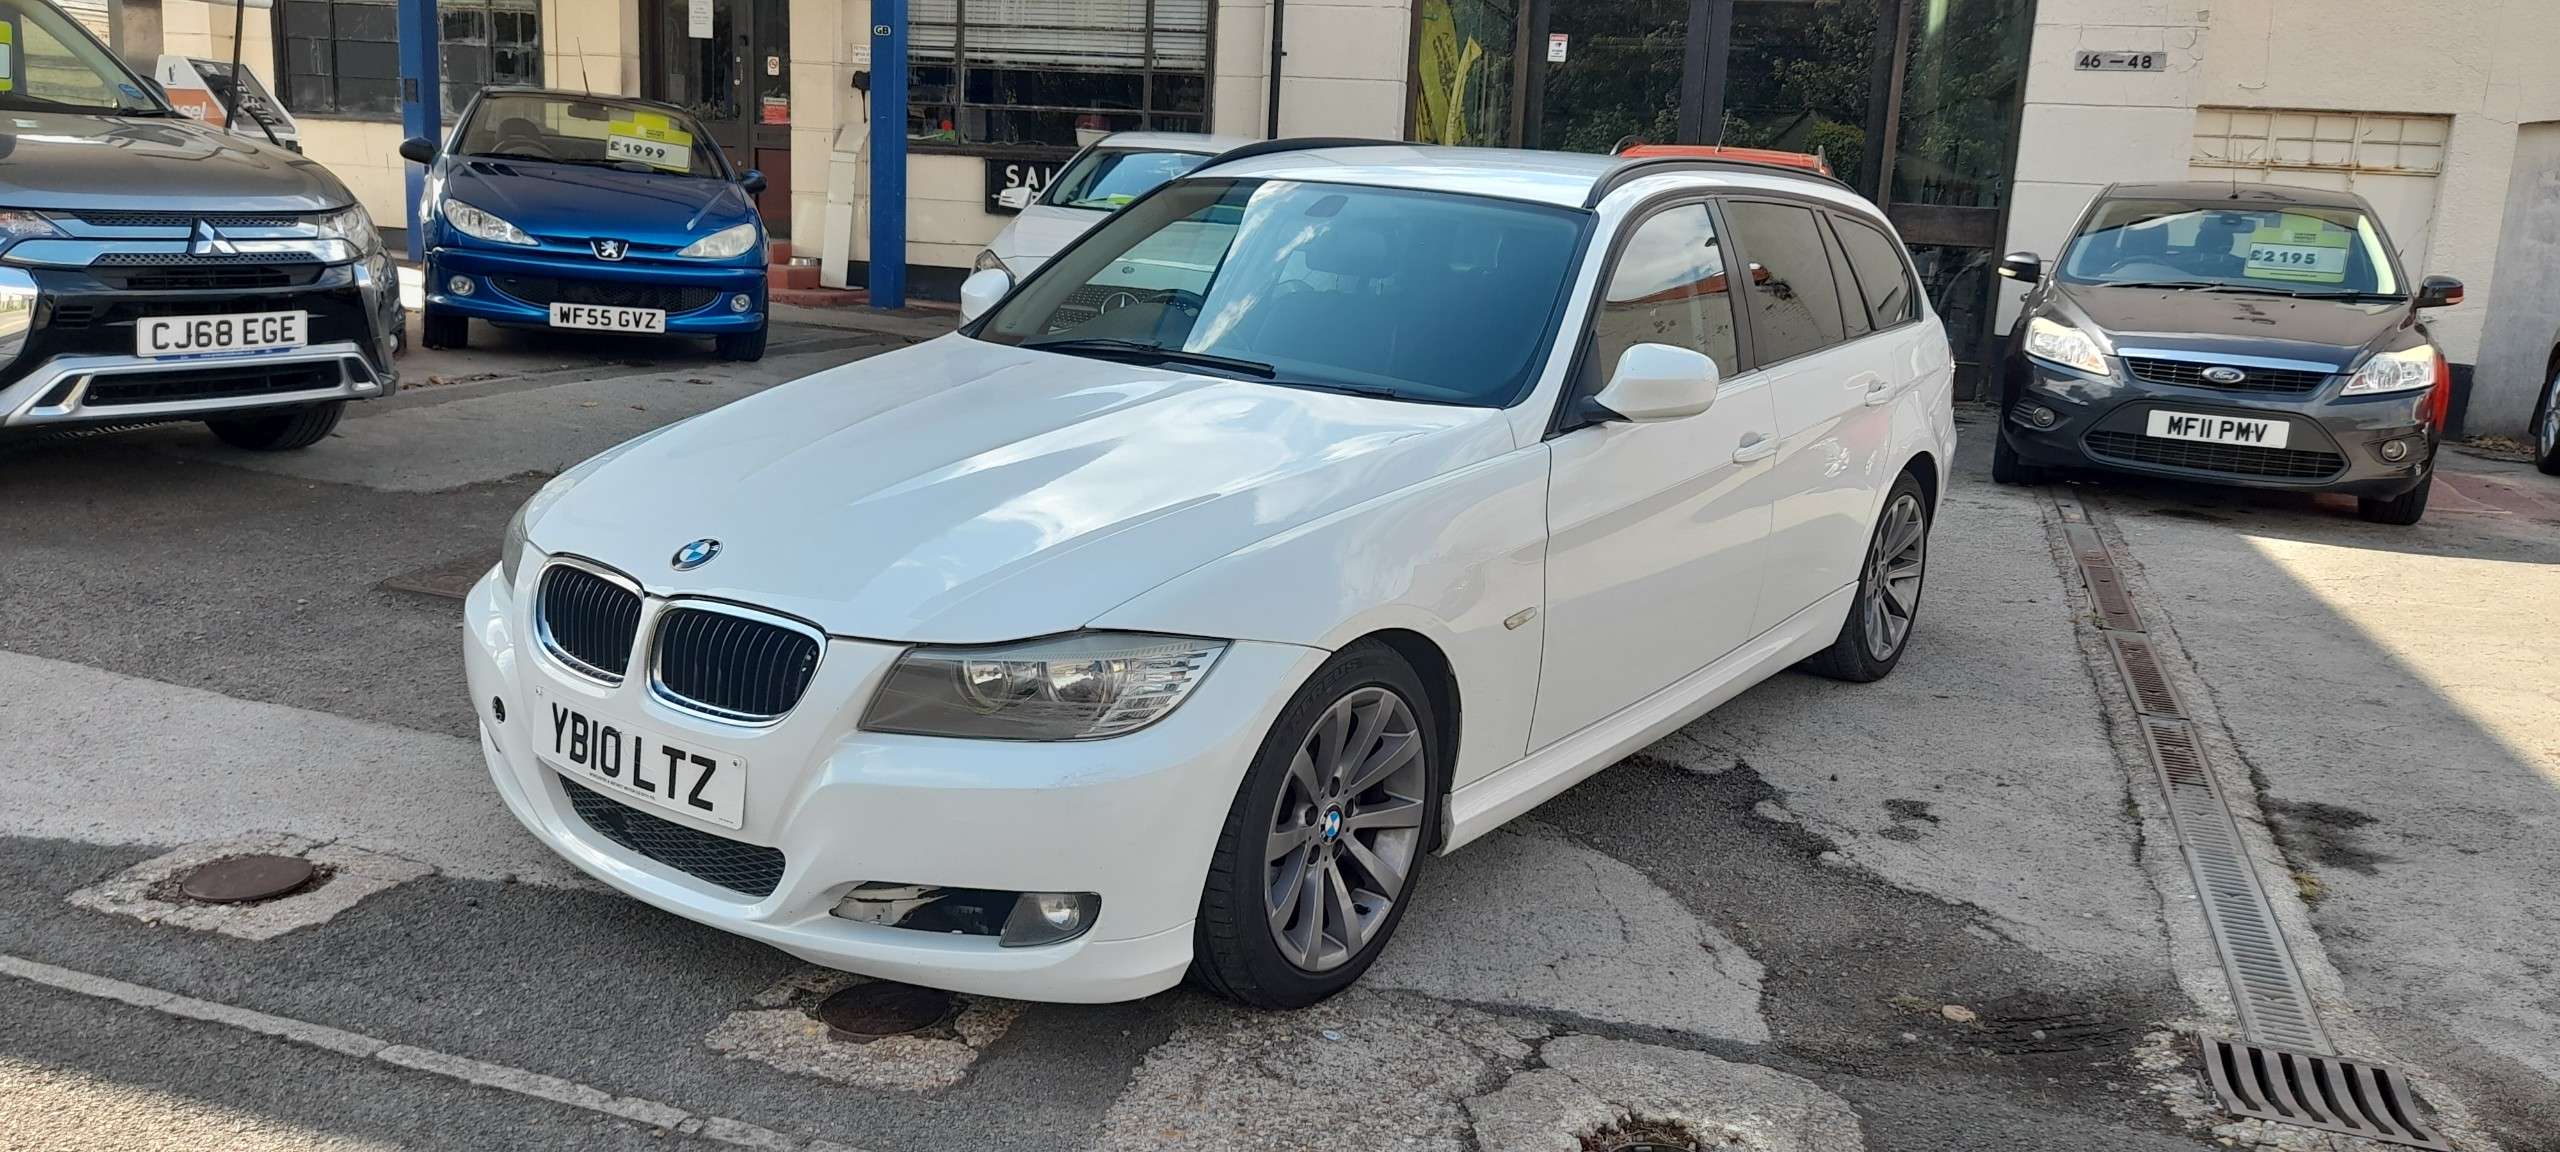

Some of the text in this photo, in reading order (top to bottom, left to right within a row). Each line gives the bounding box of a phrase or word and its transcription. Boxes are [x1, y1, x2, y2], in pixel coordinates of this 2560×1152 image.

[2080, 54, 2101, 69] 46
[2127, 55, 2152, 69] 48
[610, 140, 666, 158] £1999
[2250, 249, 2316, 265] £2195
[559, 306, 657, 329] WF55 GVZ
[152, 315, 296, 350] CJ68 EGE
[2167, 415, 2268, 443] MF11 PMV
[552, 702, 622, 778] YB10
[633, 735, 717, 812] LTZ
